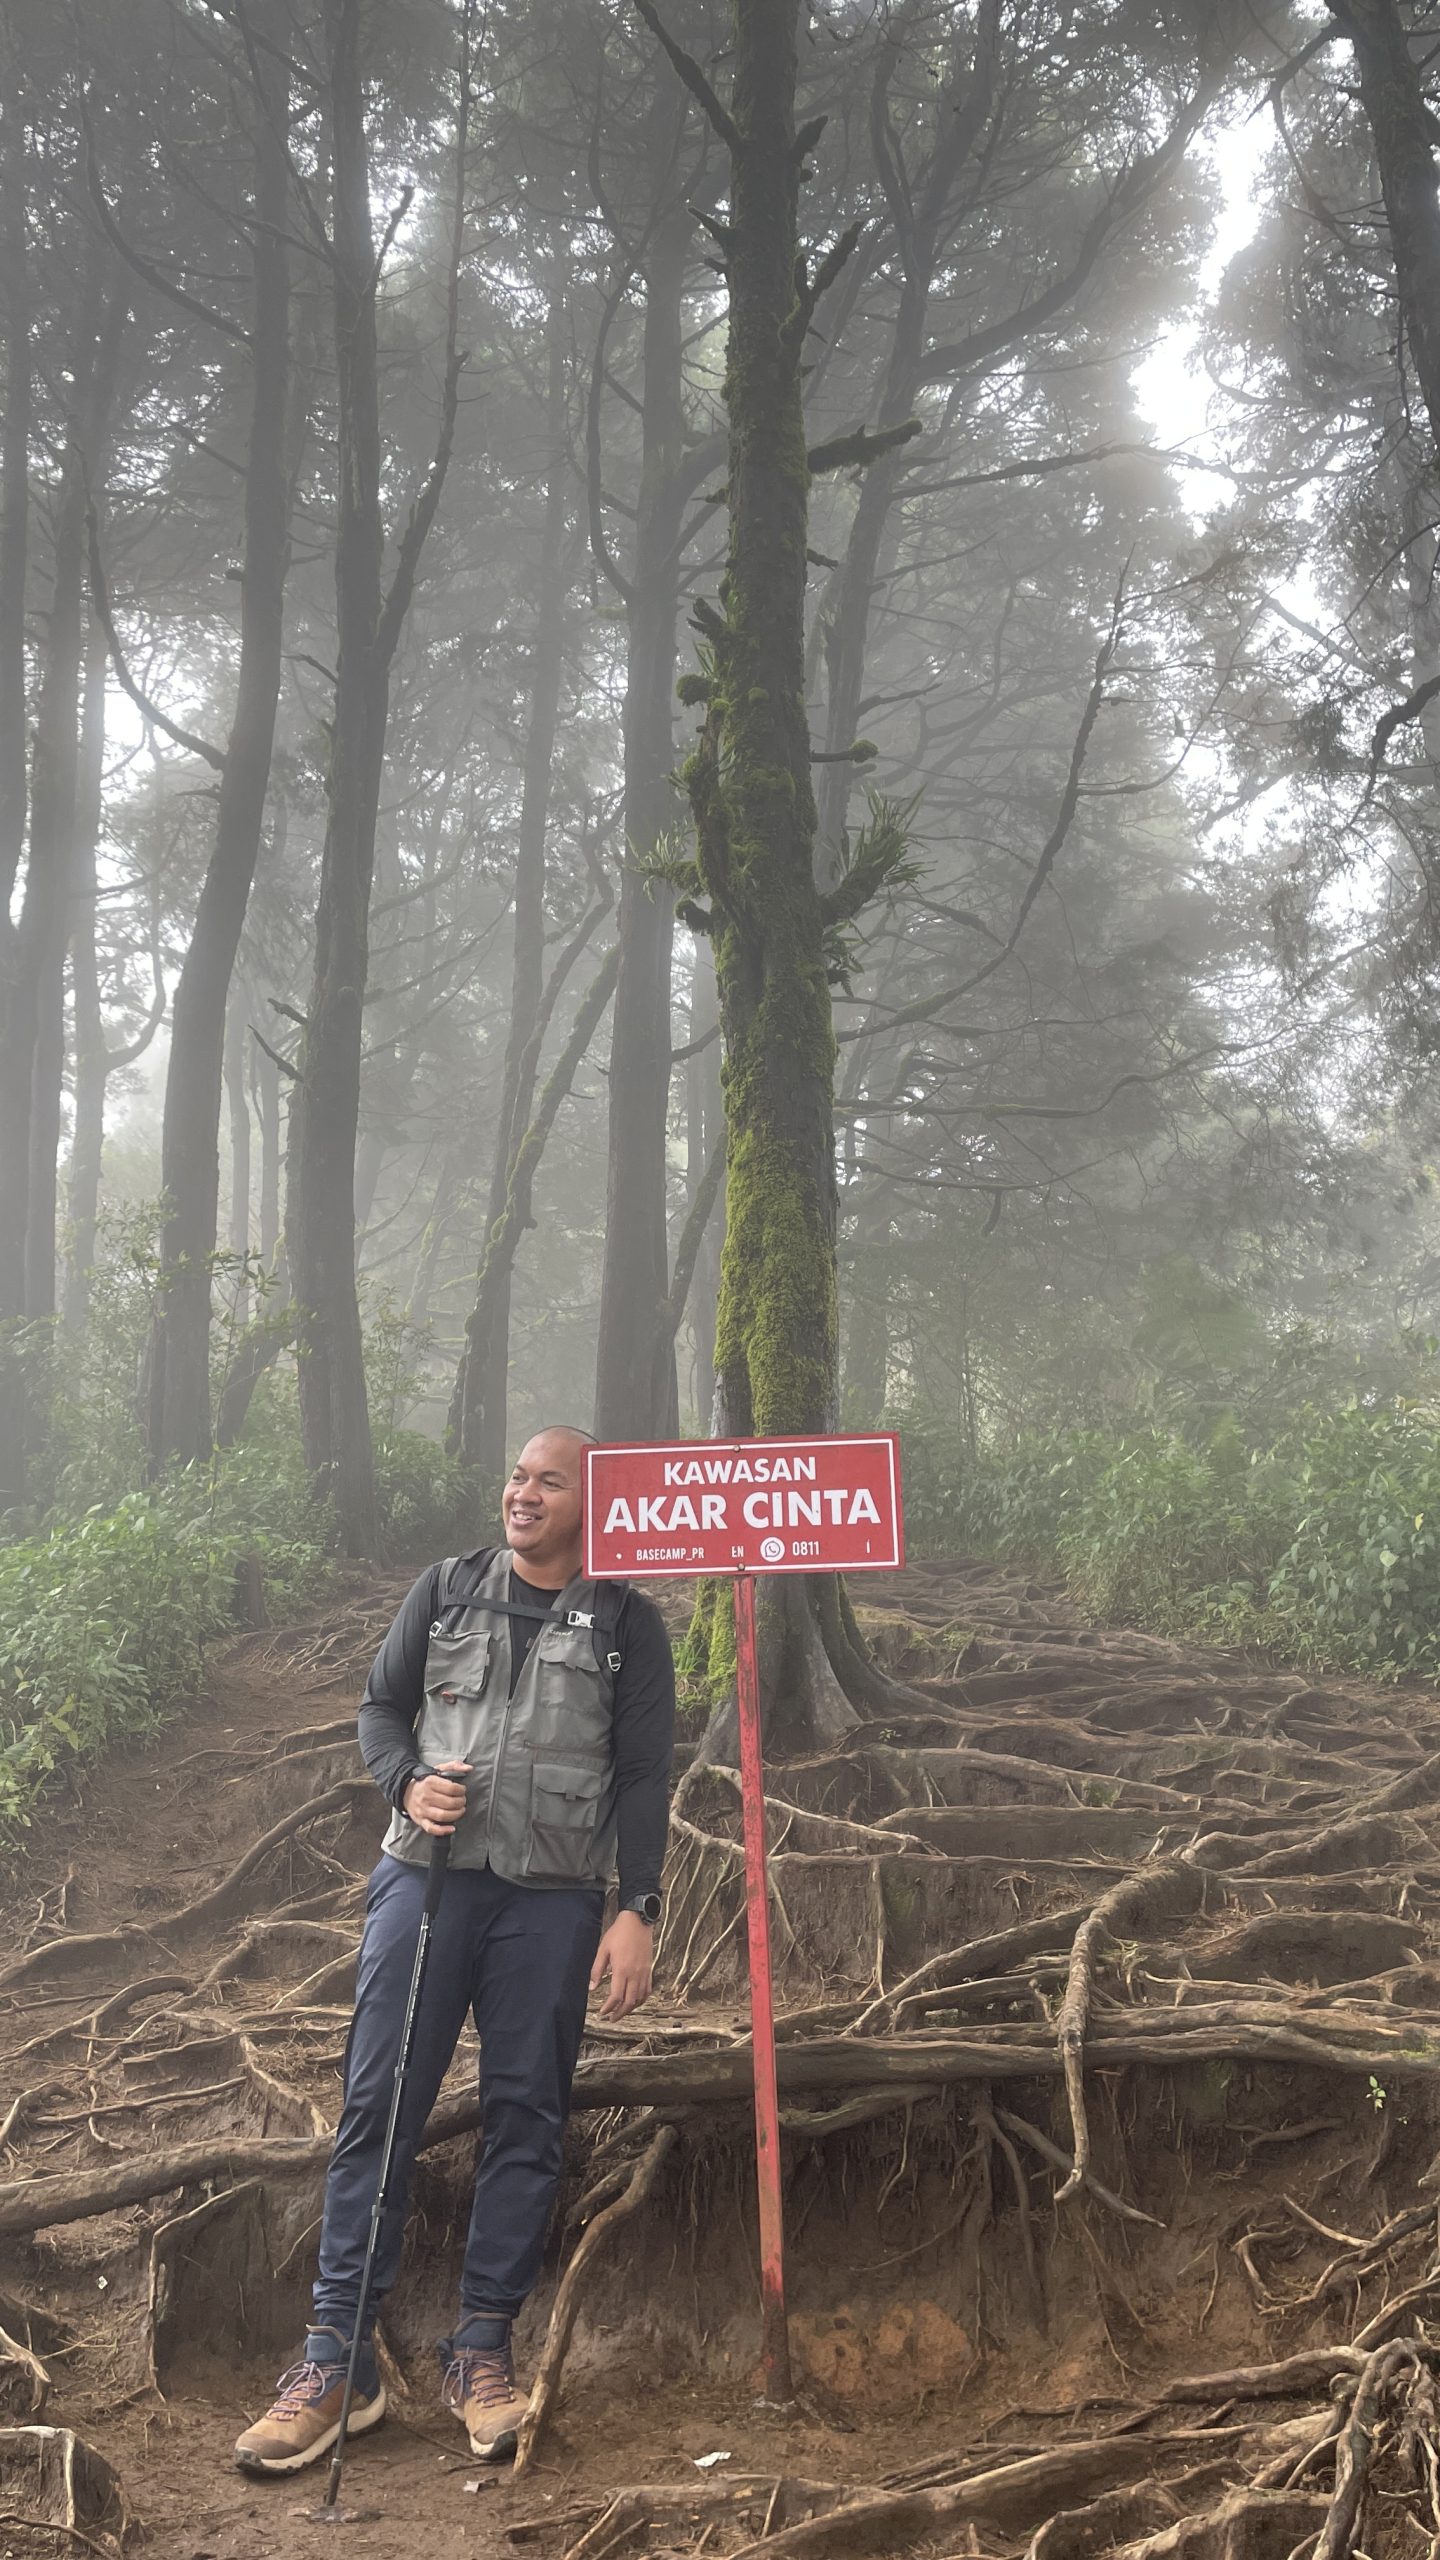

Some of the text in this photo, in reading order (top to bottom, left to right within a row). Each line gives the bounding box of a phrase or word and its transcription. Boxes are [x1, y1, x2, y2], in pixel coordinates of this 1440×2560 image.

[664, 1457, 817, 1485] KAWASAN
[603, 1489, 882, 1533] AKAR CINTA
[636, 1547, 705, 1561] BASECAMP_PR
[792, 1540, 820, 1556] 0811
